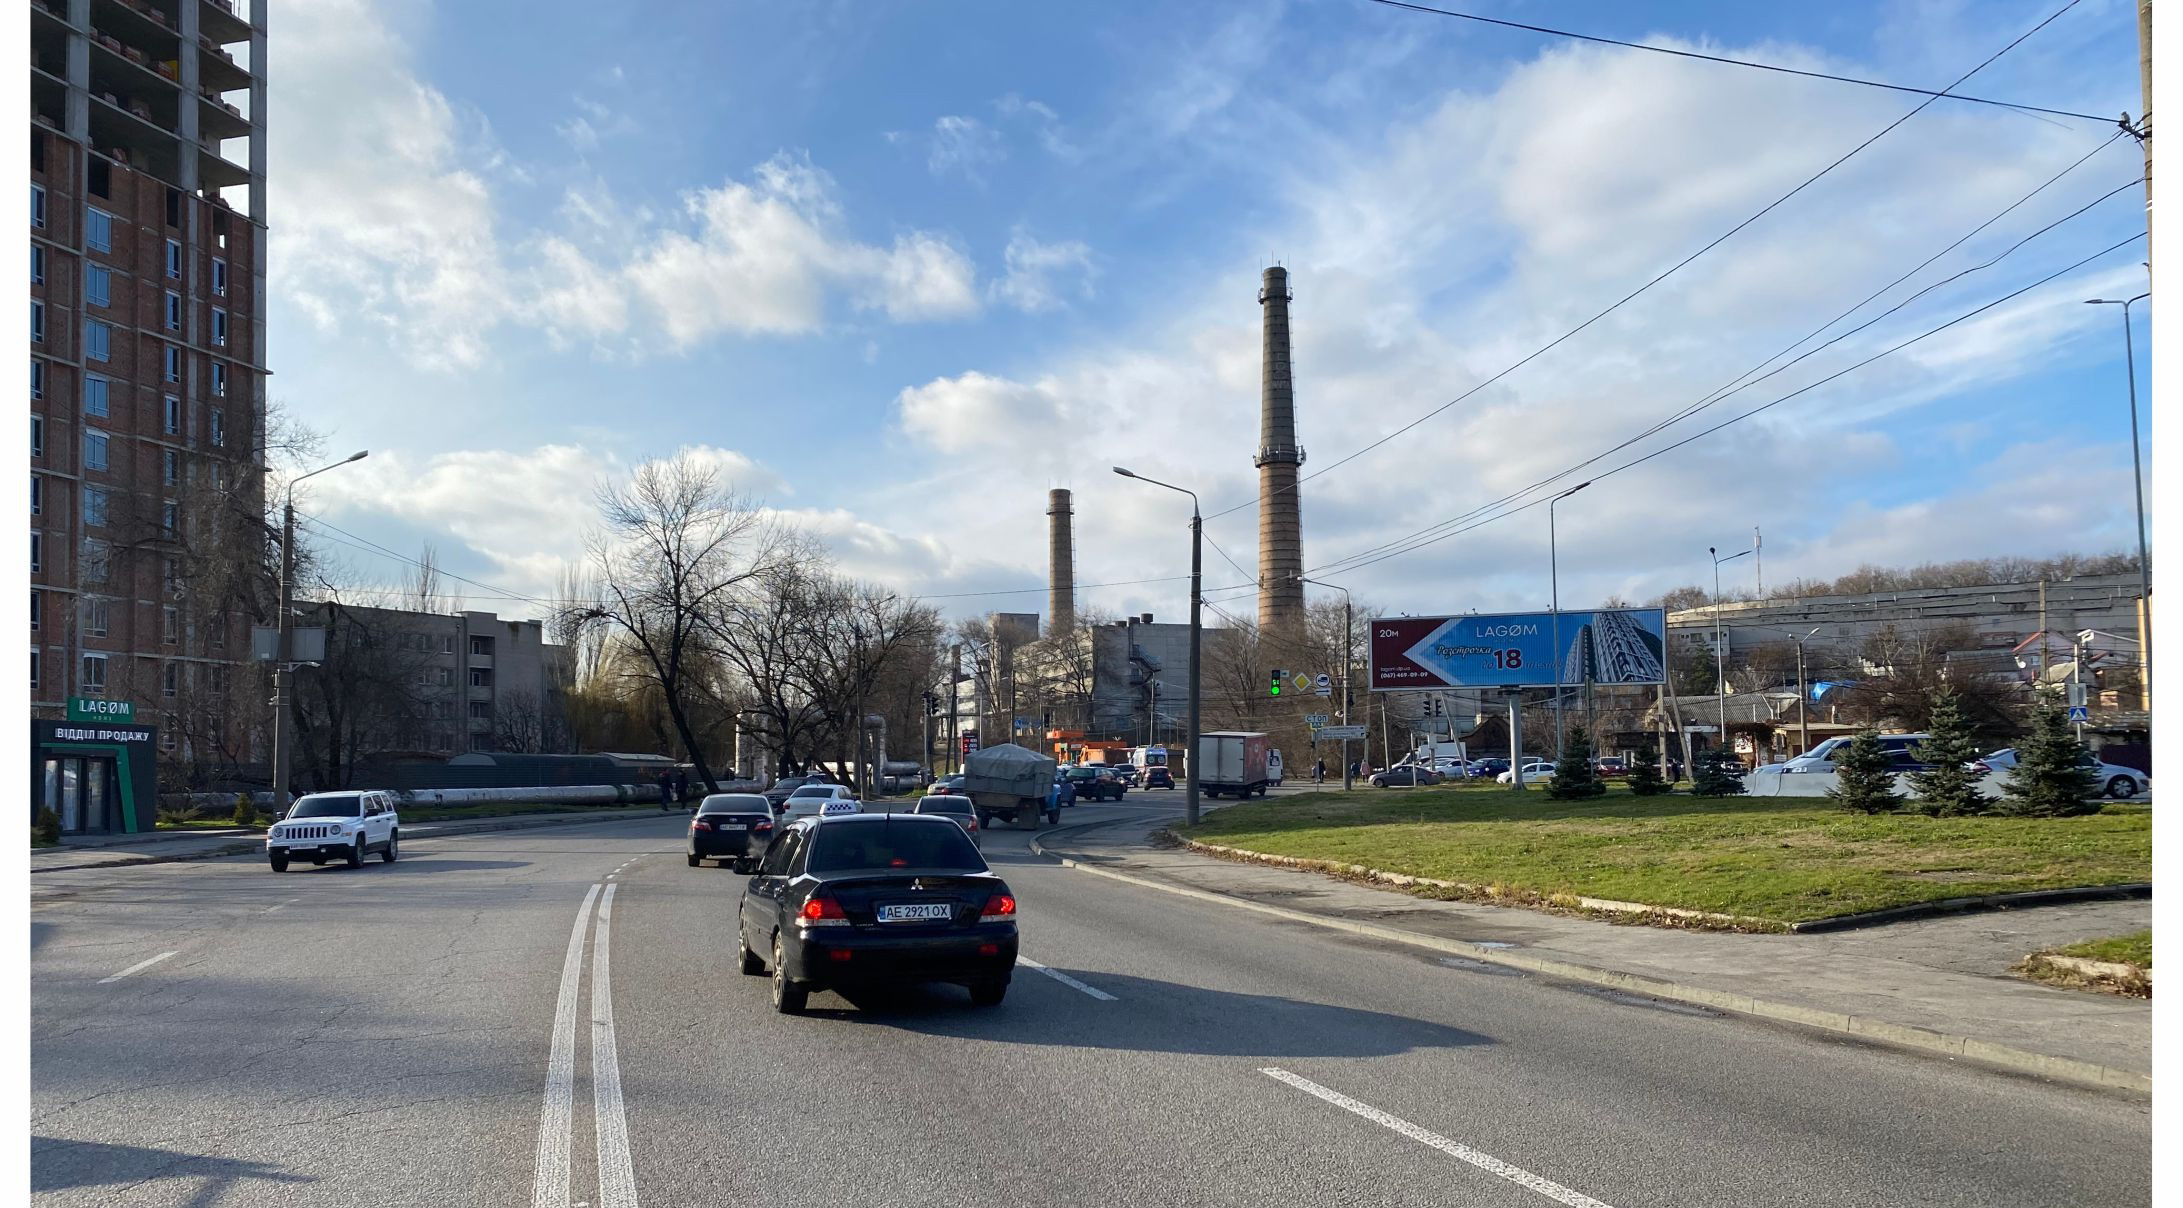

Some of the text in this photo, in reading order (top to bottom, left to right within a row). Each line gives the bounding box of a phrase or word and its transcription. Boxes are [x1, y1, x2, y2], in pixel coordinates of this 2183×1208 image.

[1476, 624, 1538, 638] LAGØM
[1493, 648, 1522, 670] 18
[79, 699, 129, 714] LAGØM
[55, 728, 149, 741] ВІДДІЛ ПРОДАЖУ
[887, 905, 947, 918] AE 2921 OX
